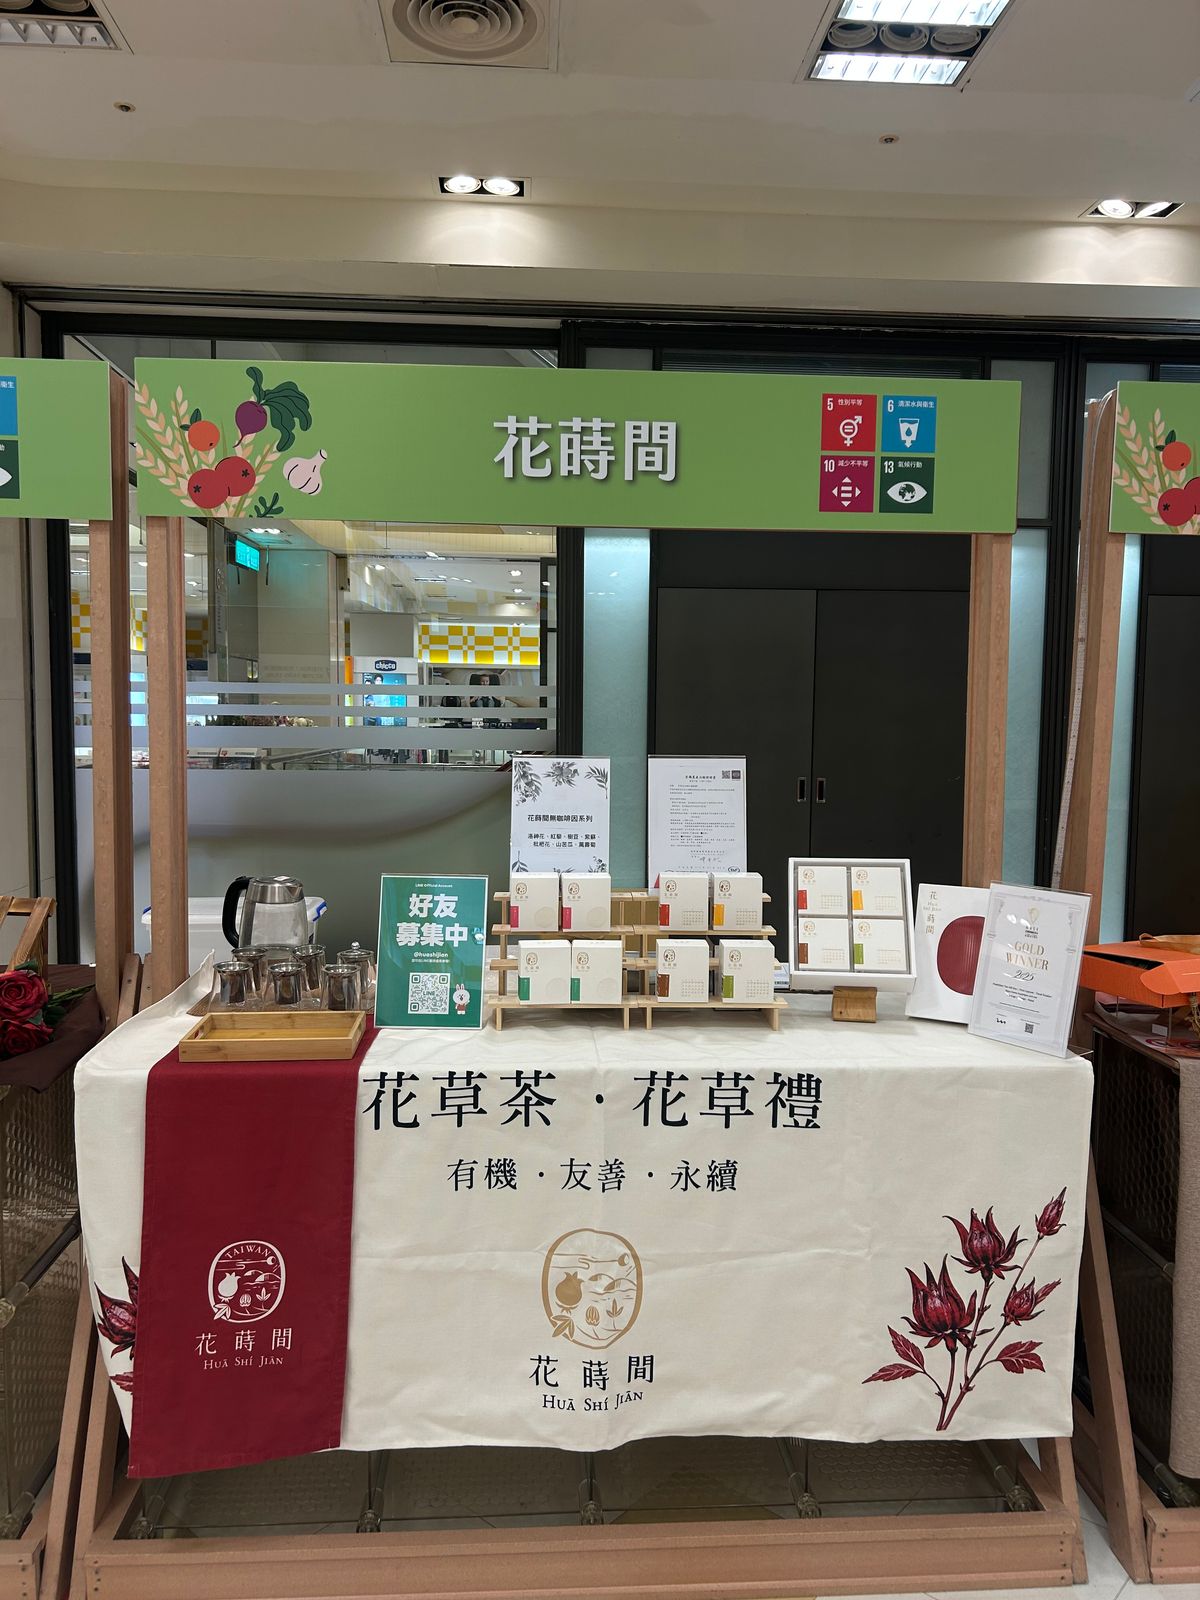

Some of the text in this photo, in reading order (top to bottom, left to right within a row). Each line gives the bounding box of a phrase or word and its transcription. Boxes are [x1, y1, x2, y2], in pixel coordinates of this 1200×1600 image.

[827, 397, 863, 411] 5 性別平等
[887, 399, 894, 412] 6
[494, 415, 677, 481] 花蒔間
[824, 459, 835, 472] 10
[884, 460, 894, 474] 13
[408, 893, 459, 918] 好友
[396, 922, 469, 948] 募集中
[1014, 941, 1045, 956] GOLD
[1006, 952, 1049, 971] WINNER
[225, 1244, 271, 1260] TAIWAN
[194, 1327, 292, 1356] 花蒔間
[529, 1354, 654, 1391] 花蒔間
